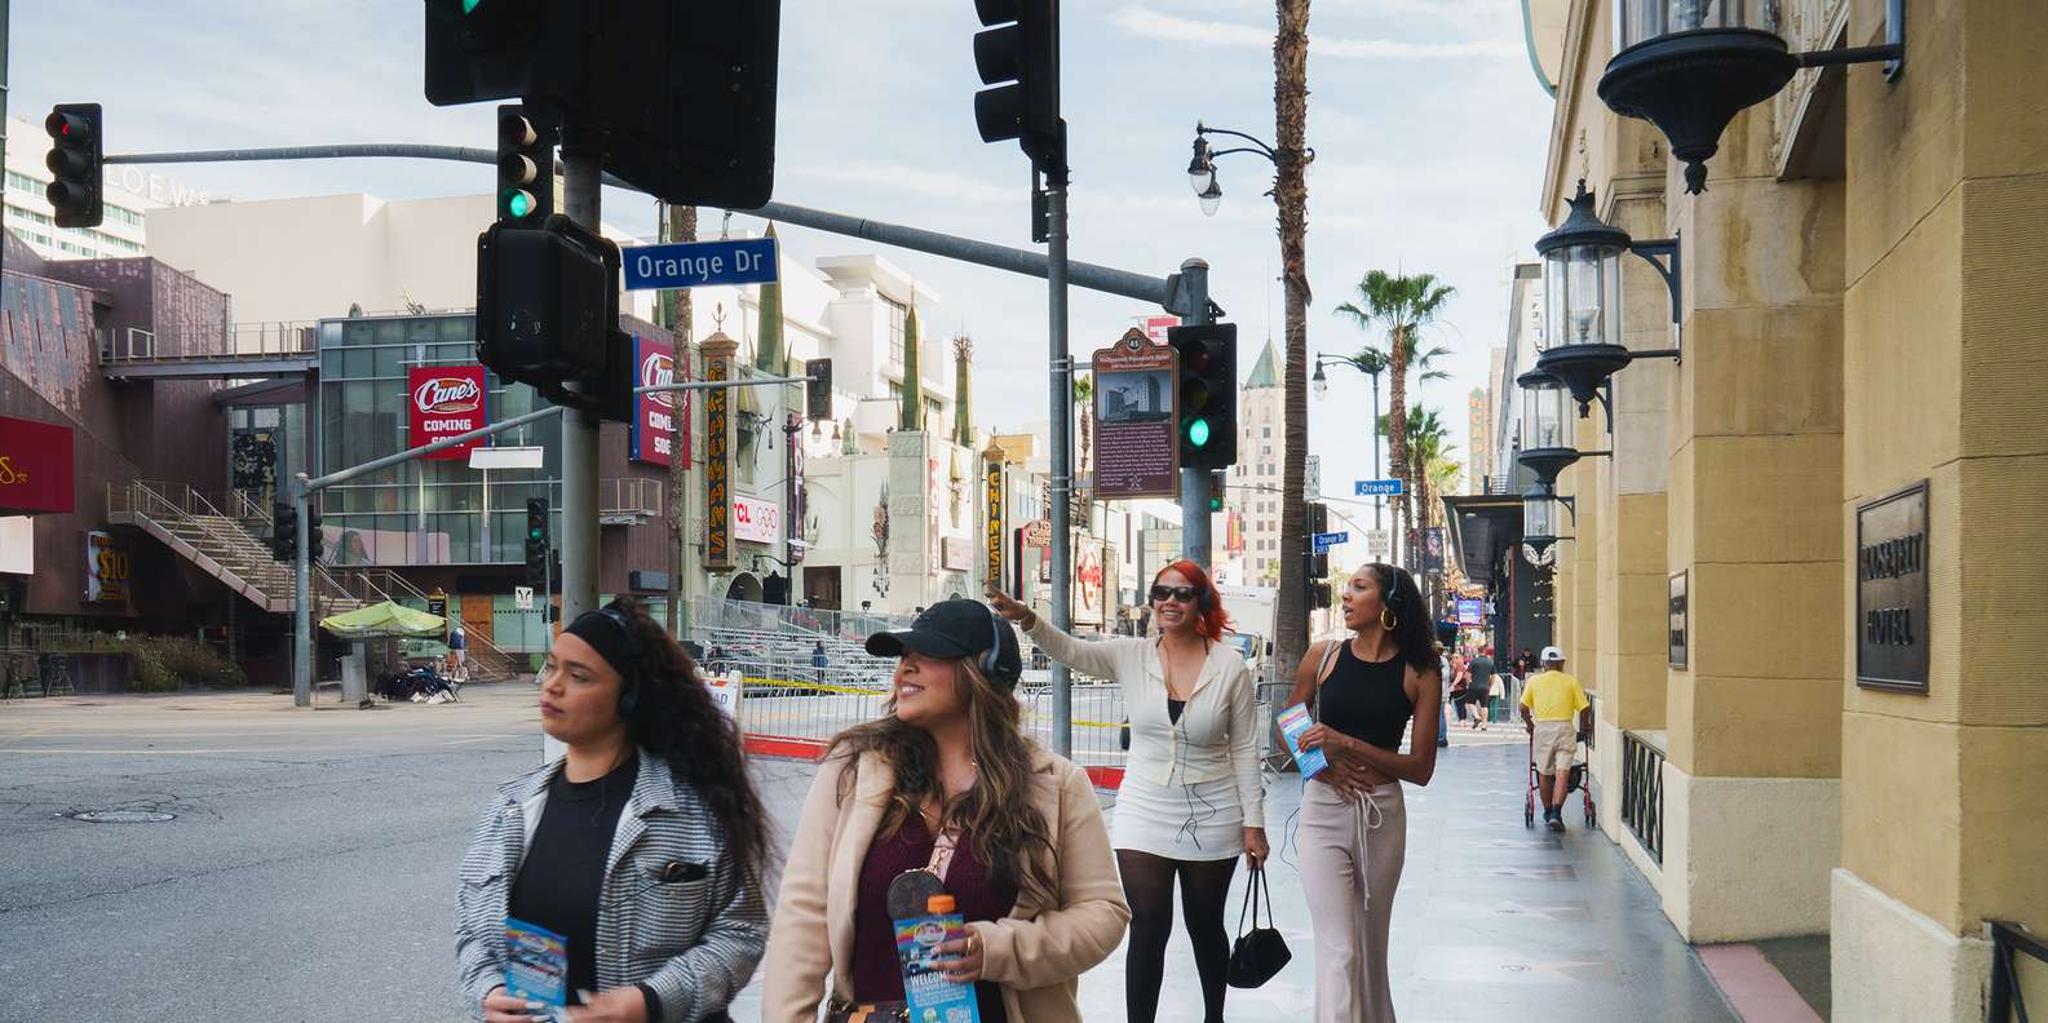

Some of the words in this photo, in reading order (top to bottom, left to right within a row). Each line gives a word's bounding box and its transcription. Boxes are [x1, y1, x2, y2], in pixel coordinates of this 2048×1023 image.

[105, 164, 208, 207] LOEWS
[637, 255, 723, 281] Orange
[735, 250, 762, 272] Dr
[419, 378, 477, 411] Cane's
[424, 419, 472, 431] COMING
[1361, 484, 1395, 493] Orange
[733, 503, 751, 523] CL
[988, 471, 1002, 581] CHINESE
[100, 550, 129, 580] $10
[1868, 607, 1914, 645] HOTEL
